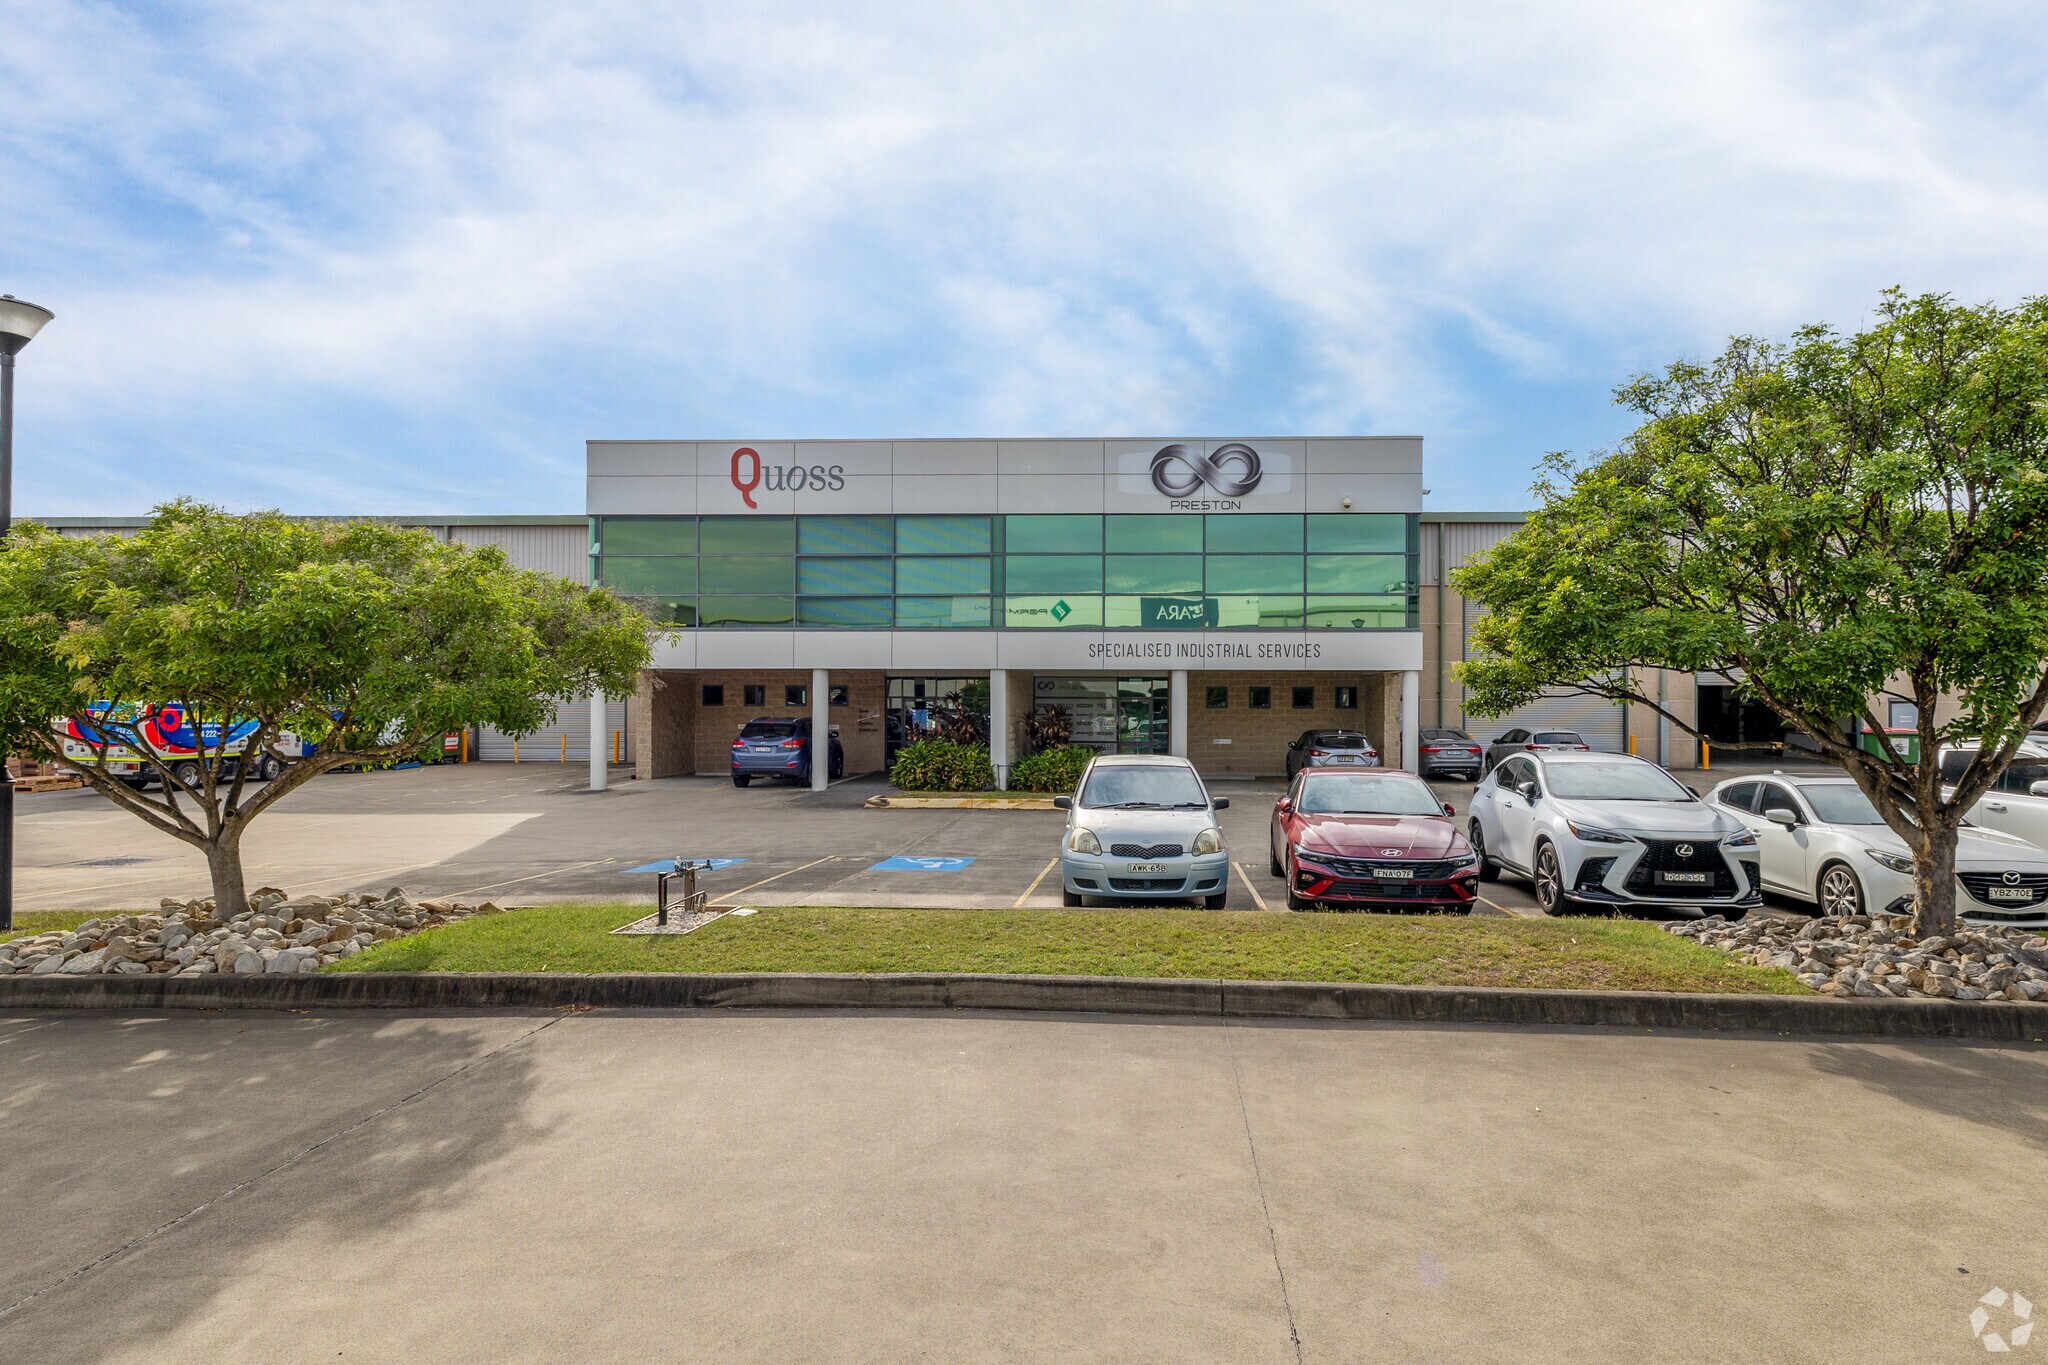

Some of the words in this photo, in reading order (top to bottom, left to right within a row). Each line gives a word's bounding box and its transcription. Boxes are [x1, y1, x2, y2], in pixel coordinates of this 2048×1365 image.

[731, 447, 844, 509] Quoss
[1170, 500, 1241, 510] PRESTON
[1088, 643, 1172, 658] SPECIALISED
[1176, 643, 1252, 658] INDUSTRIAL
[1258, 643, 1321, 658] SERVICES
